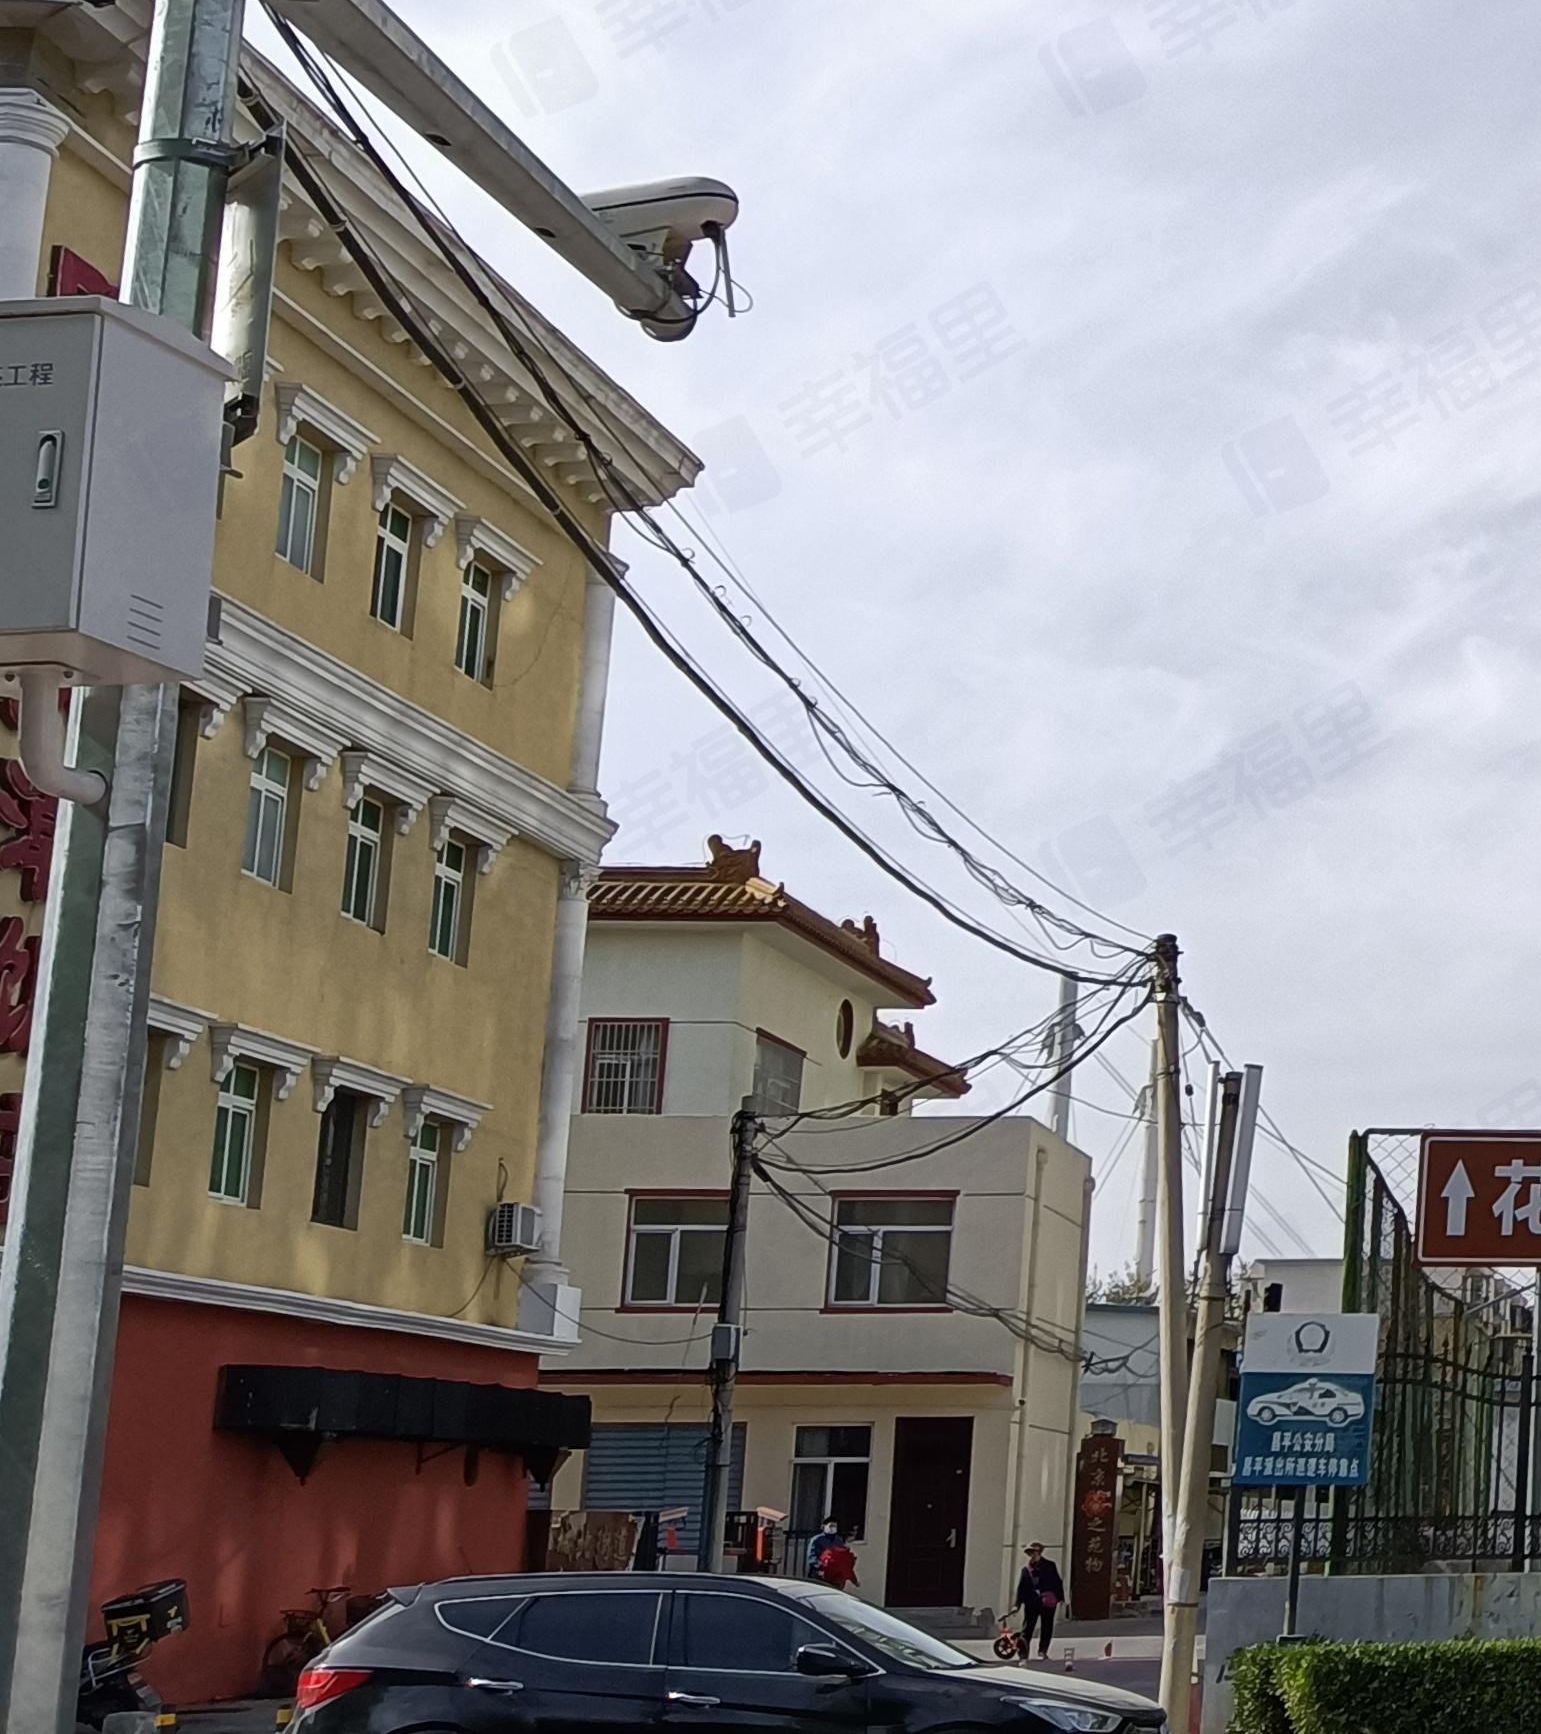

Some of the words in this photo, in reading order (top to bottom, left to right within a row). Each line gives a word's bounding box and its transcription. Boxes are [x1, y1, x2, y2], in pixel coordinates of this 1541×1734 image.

[0, 362, 54, 386] 工程
[1271, 1431, 1335, 1453] 昌平公安分局
